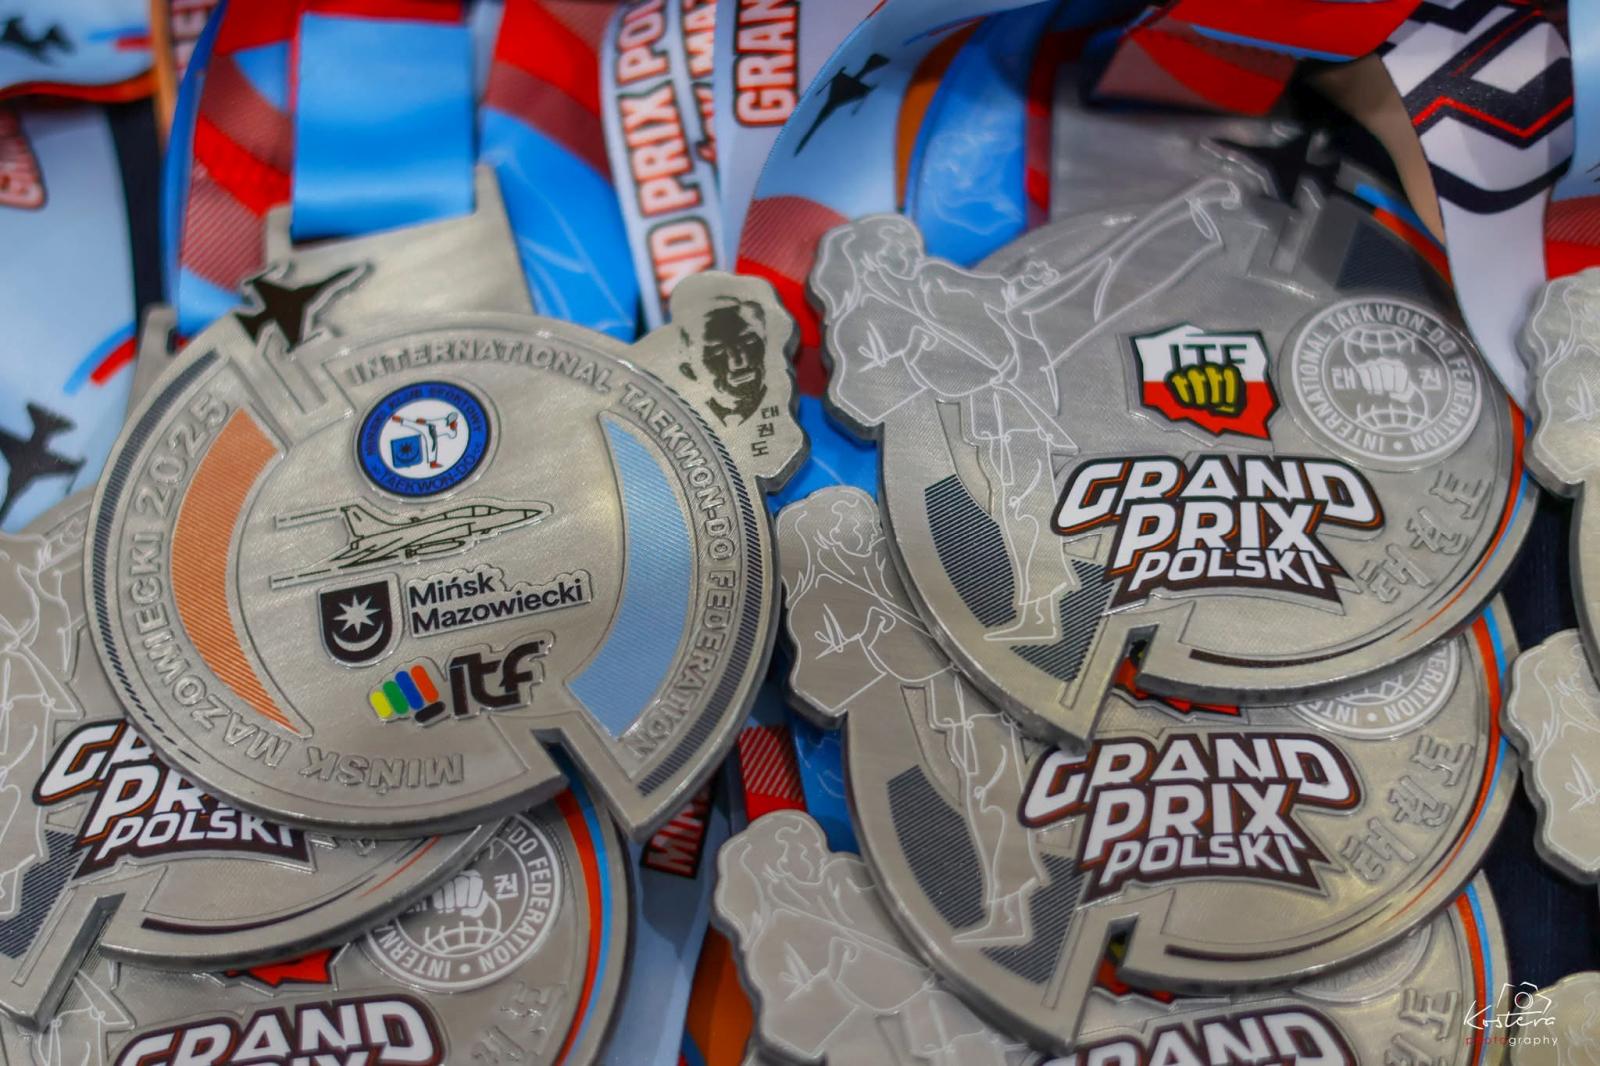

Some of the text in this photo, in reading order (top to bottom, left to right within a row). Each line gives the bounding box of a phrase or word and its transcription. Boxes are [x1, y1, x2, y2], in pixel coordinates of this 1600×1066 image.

[621, 82, 703, 218] PRIX
[1300, 304, 1473, 452] INTERNATIONAL TAEKWON-DO FEDERATION
[136, 394, 230, 518] 2025
[1056, 458, 1378, 530] GRAND
[348, 338, 736, 760] INTERNATIONAL TAEKWON-DO FEDERATION
[1113, 501, 1330, 570] PRIX
[1128, 547, 1325, 593] POLSKI
[409, 572, 495, 608] Mińsk
[412, 578, 583, 634] Mazowiecki
[130, 532, 292, 768] MAZOWIECKI
[1024, 734, 1353, 816] GRAND
[94, 807, 294, 861] POLSKI
[1084, 781, 1306, 862] PRIX
[1100, 835, 1300, 884] POLSKI
[478, 859, 552, 974] FEDERATION
